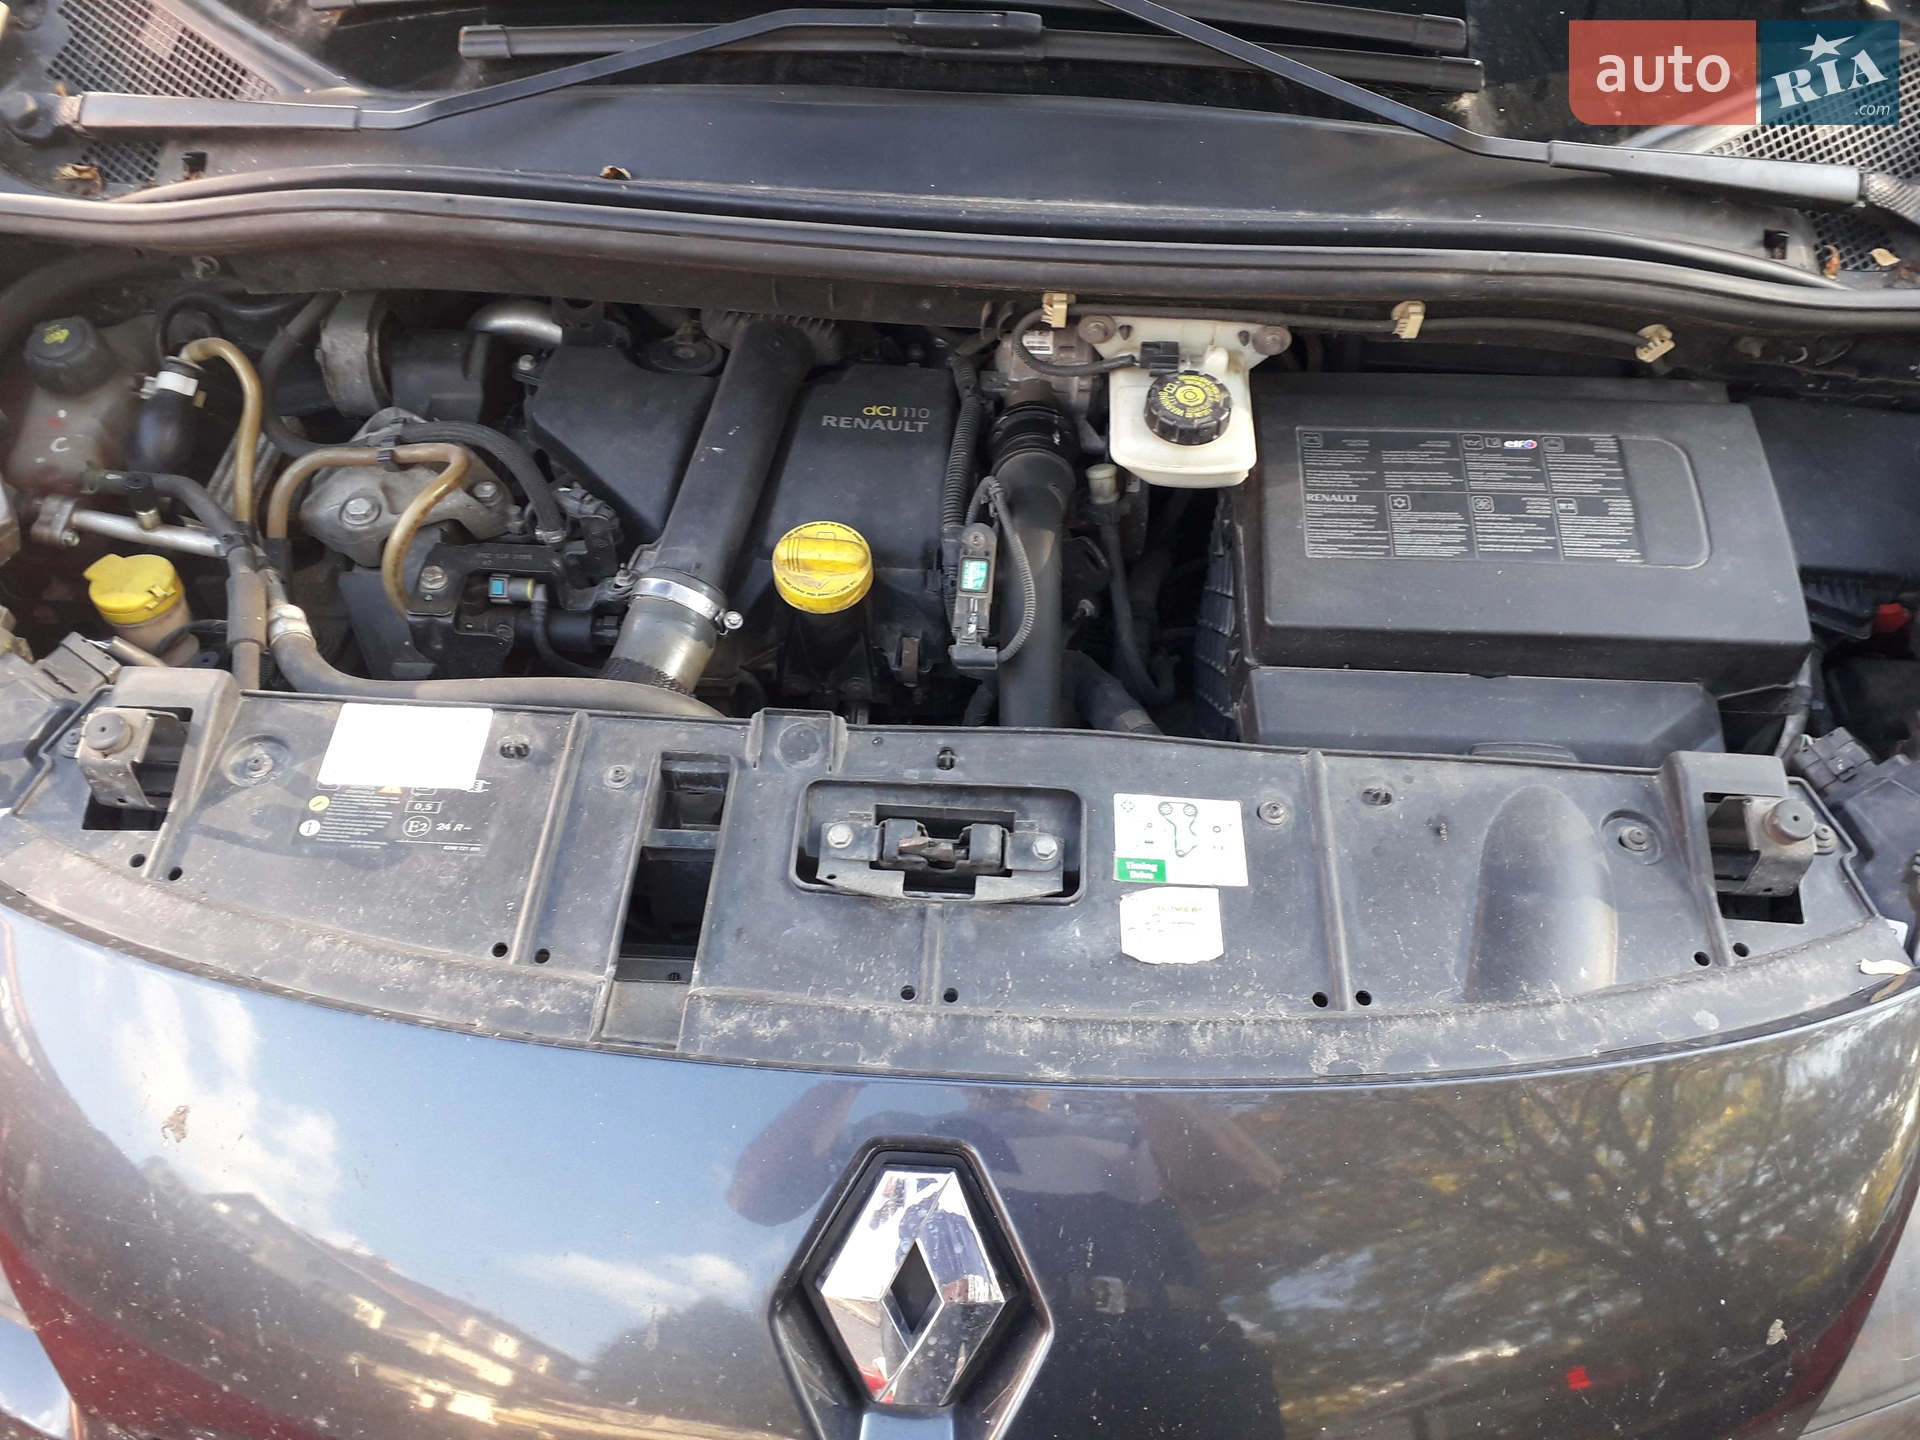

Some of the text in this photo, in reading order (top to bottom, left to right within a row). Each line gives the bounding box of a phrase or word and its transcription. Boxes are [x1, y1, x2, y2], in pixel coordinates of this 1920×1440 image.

[902, 407, 930, 419] 110
[822, 415, 929, 432] RENAULT
[1306, 493, 1359, 503] RENAULT
[413, 803, 434, 812] 0,5
[435, 822, 452, 831] 24
[1125, 860, 1158, 872] Timing
[1129, 870, 1155, 880] Drive
